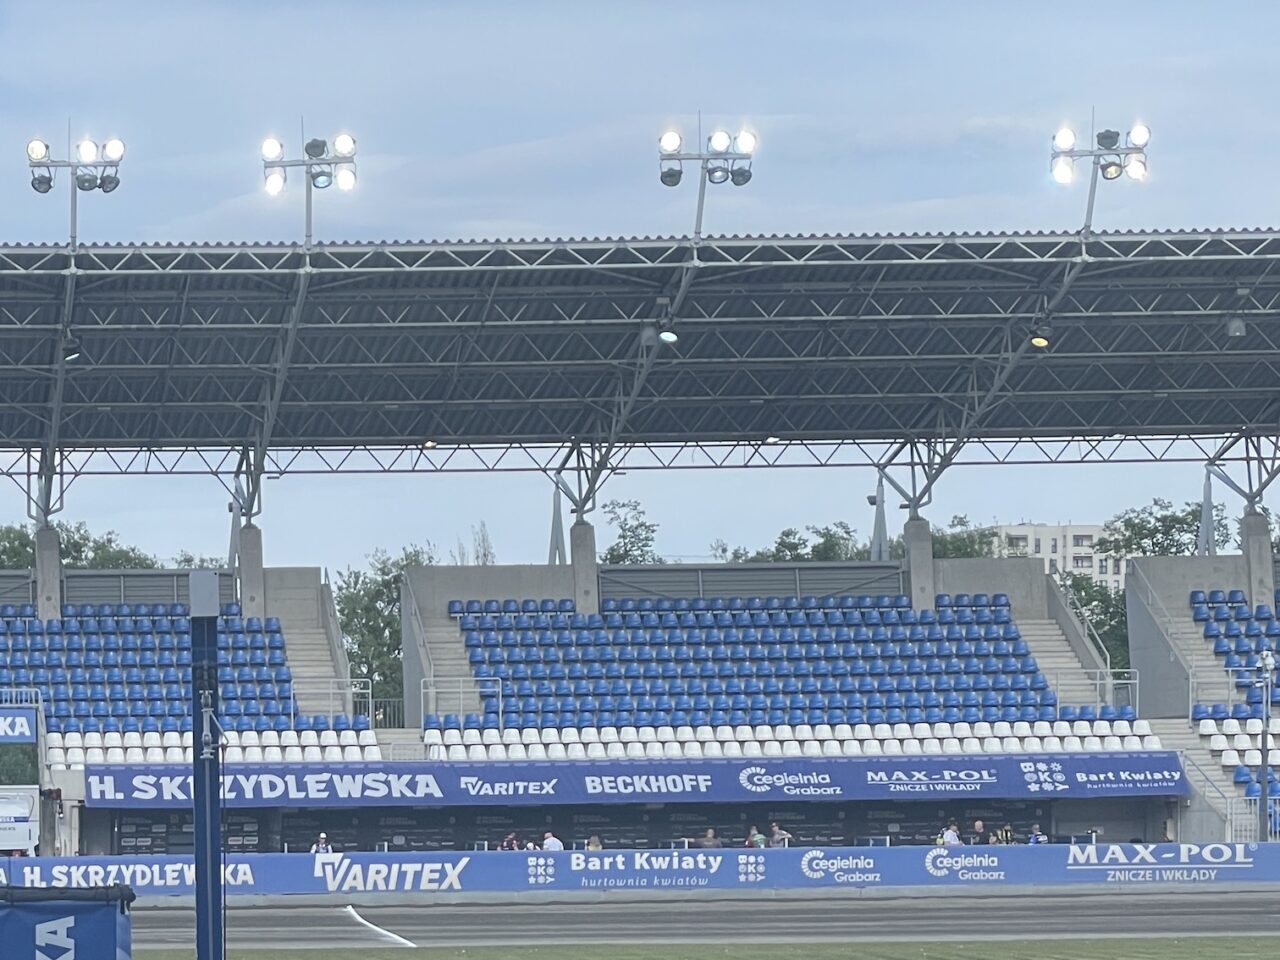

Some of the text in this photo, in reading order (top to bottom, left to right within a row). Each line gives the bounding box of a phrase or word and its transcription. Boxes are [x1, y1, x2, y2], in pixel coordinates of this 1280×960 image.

[754, 772, 831, 786] cegielnia
[867, 770, 997, 782] MAX-POL
[1076, 769, 1181, 782] Bart Kwiaty
[88, 775, 124, 800] H.
[461, 776, 558, 796] VARITEX
[585, 775, 712, 794] BECKHOFF
[784, 785, 842, 796] Grabarz
[889, 783, 928, 792] ZNICZE
[935, 783, 982, 792] WKŁADY
[1067, 843, 1253, 864] MAX-POL
[571, 852, 722, 873] Bart Kwiaty
[812, 855, 874, 872] cegielnia
[936, 853, 998, 870] cegielnia
[23, 863, 254, 888] H. SKRZYDLEWKA
[314, 853, 471, 891] VARITEX
[835, 871, 881, 882] Grabarz
[959, 869, 1005, 880] Grabarz
[1107, 870, 1152, 881] ZNICZE
[1163, 869, 1217, 881] WKŁADY
[581, 875, 708, 887] hurtownia kwiatów
